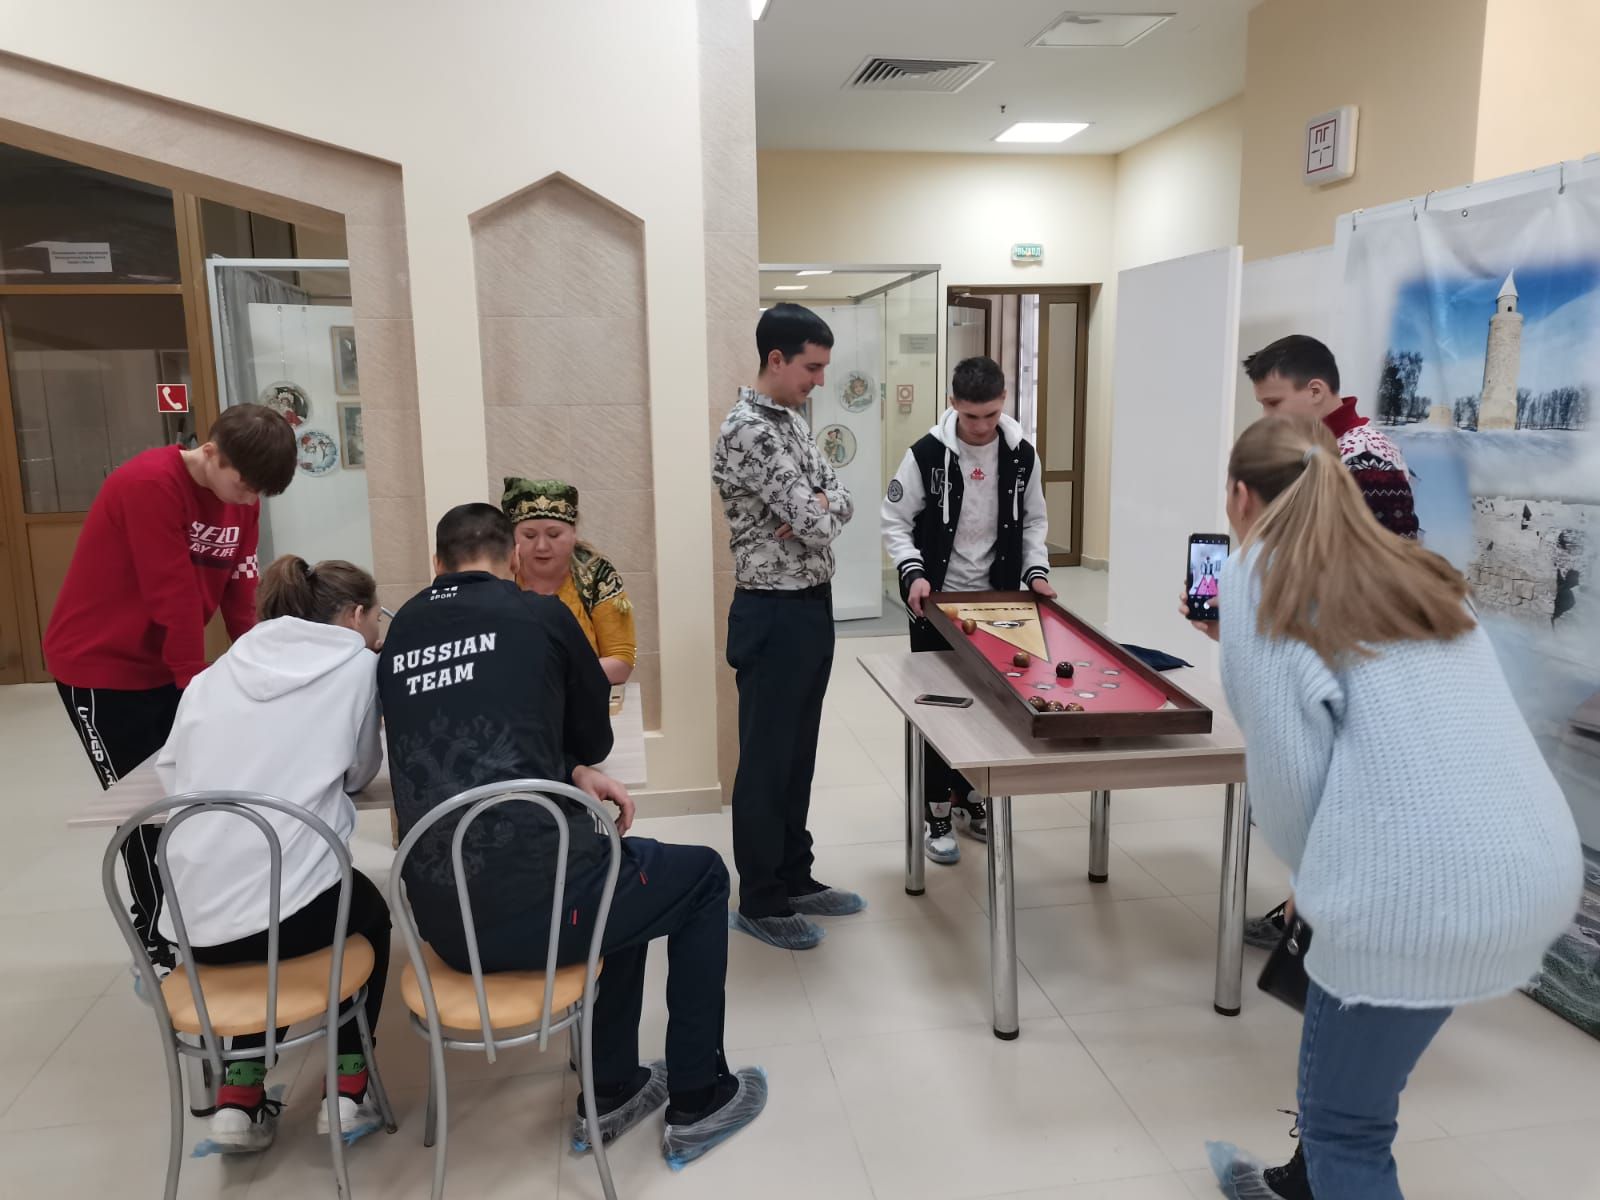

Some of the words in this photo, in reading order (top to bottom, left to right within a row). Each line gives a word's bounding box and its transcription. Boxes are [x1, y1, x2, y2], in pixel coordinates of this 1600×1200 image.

[430, 592, 458, 601] SPORT
[392, 632, 497, 674] RUSSIAN
[406, 662, 475, 696] TEAM
